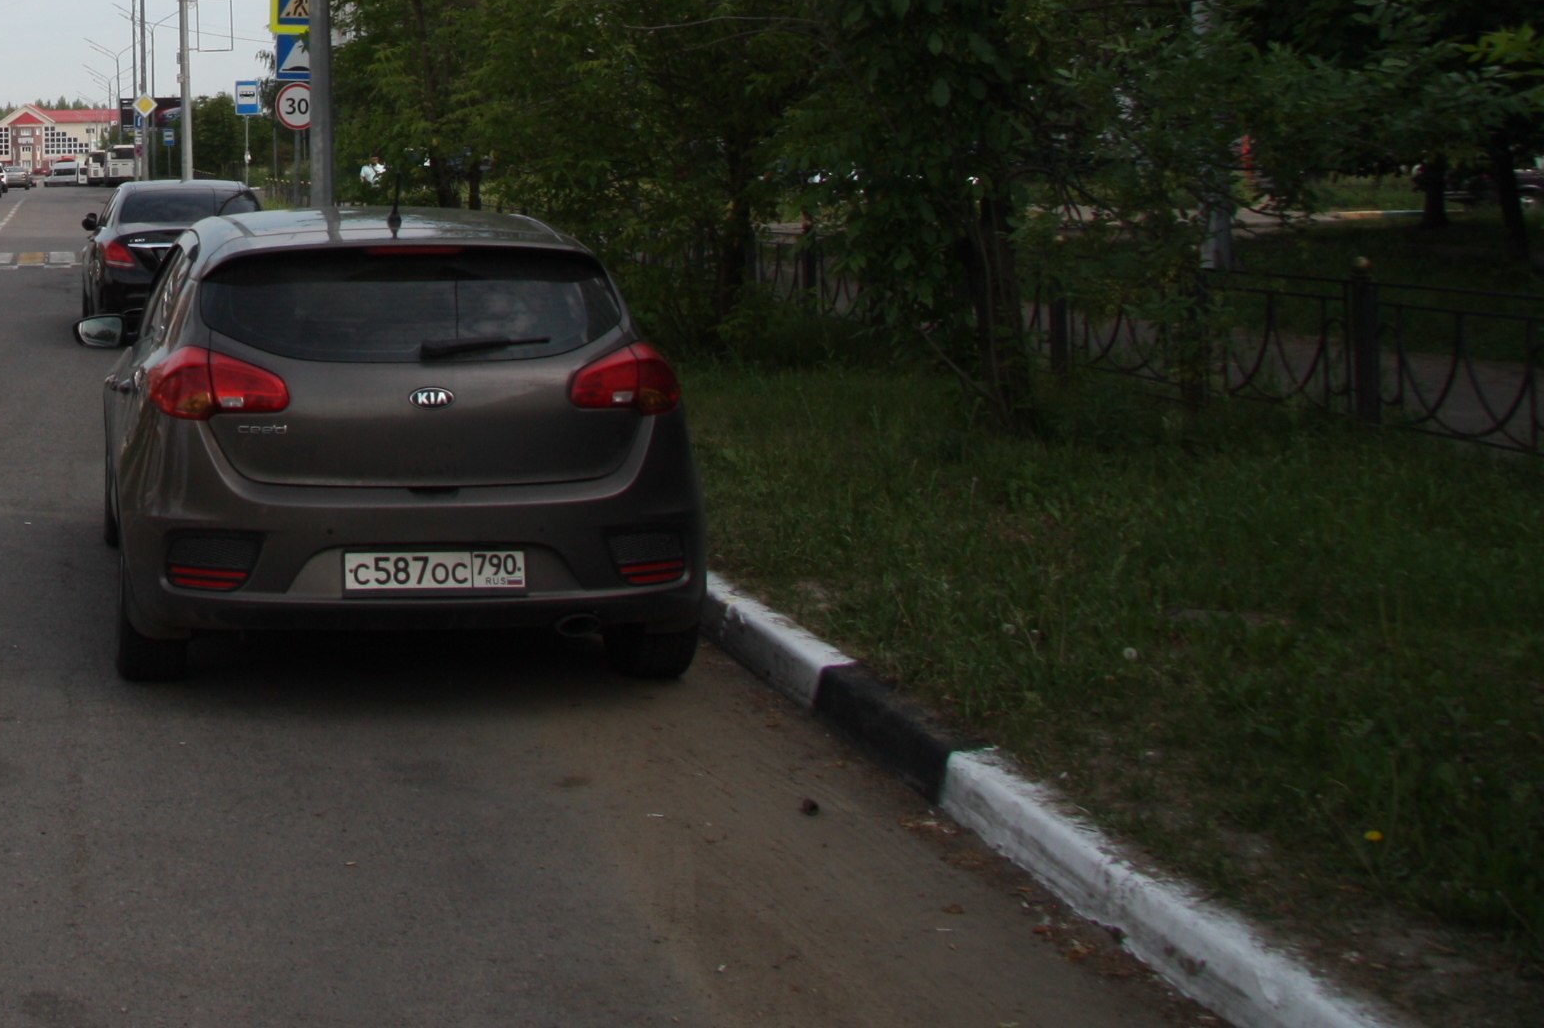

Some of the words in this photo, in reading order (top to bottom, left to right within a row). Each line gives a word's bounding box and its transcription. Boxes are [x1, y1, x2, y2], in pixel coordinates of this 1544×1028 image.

[285, 97, 309, 115] 30
[417, 392, 448, 405] KIA
[353, 556, 469, 585] С587ОС
[473, 553, 518, 576] 790
[485, 576, 506, 586] RUS
